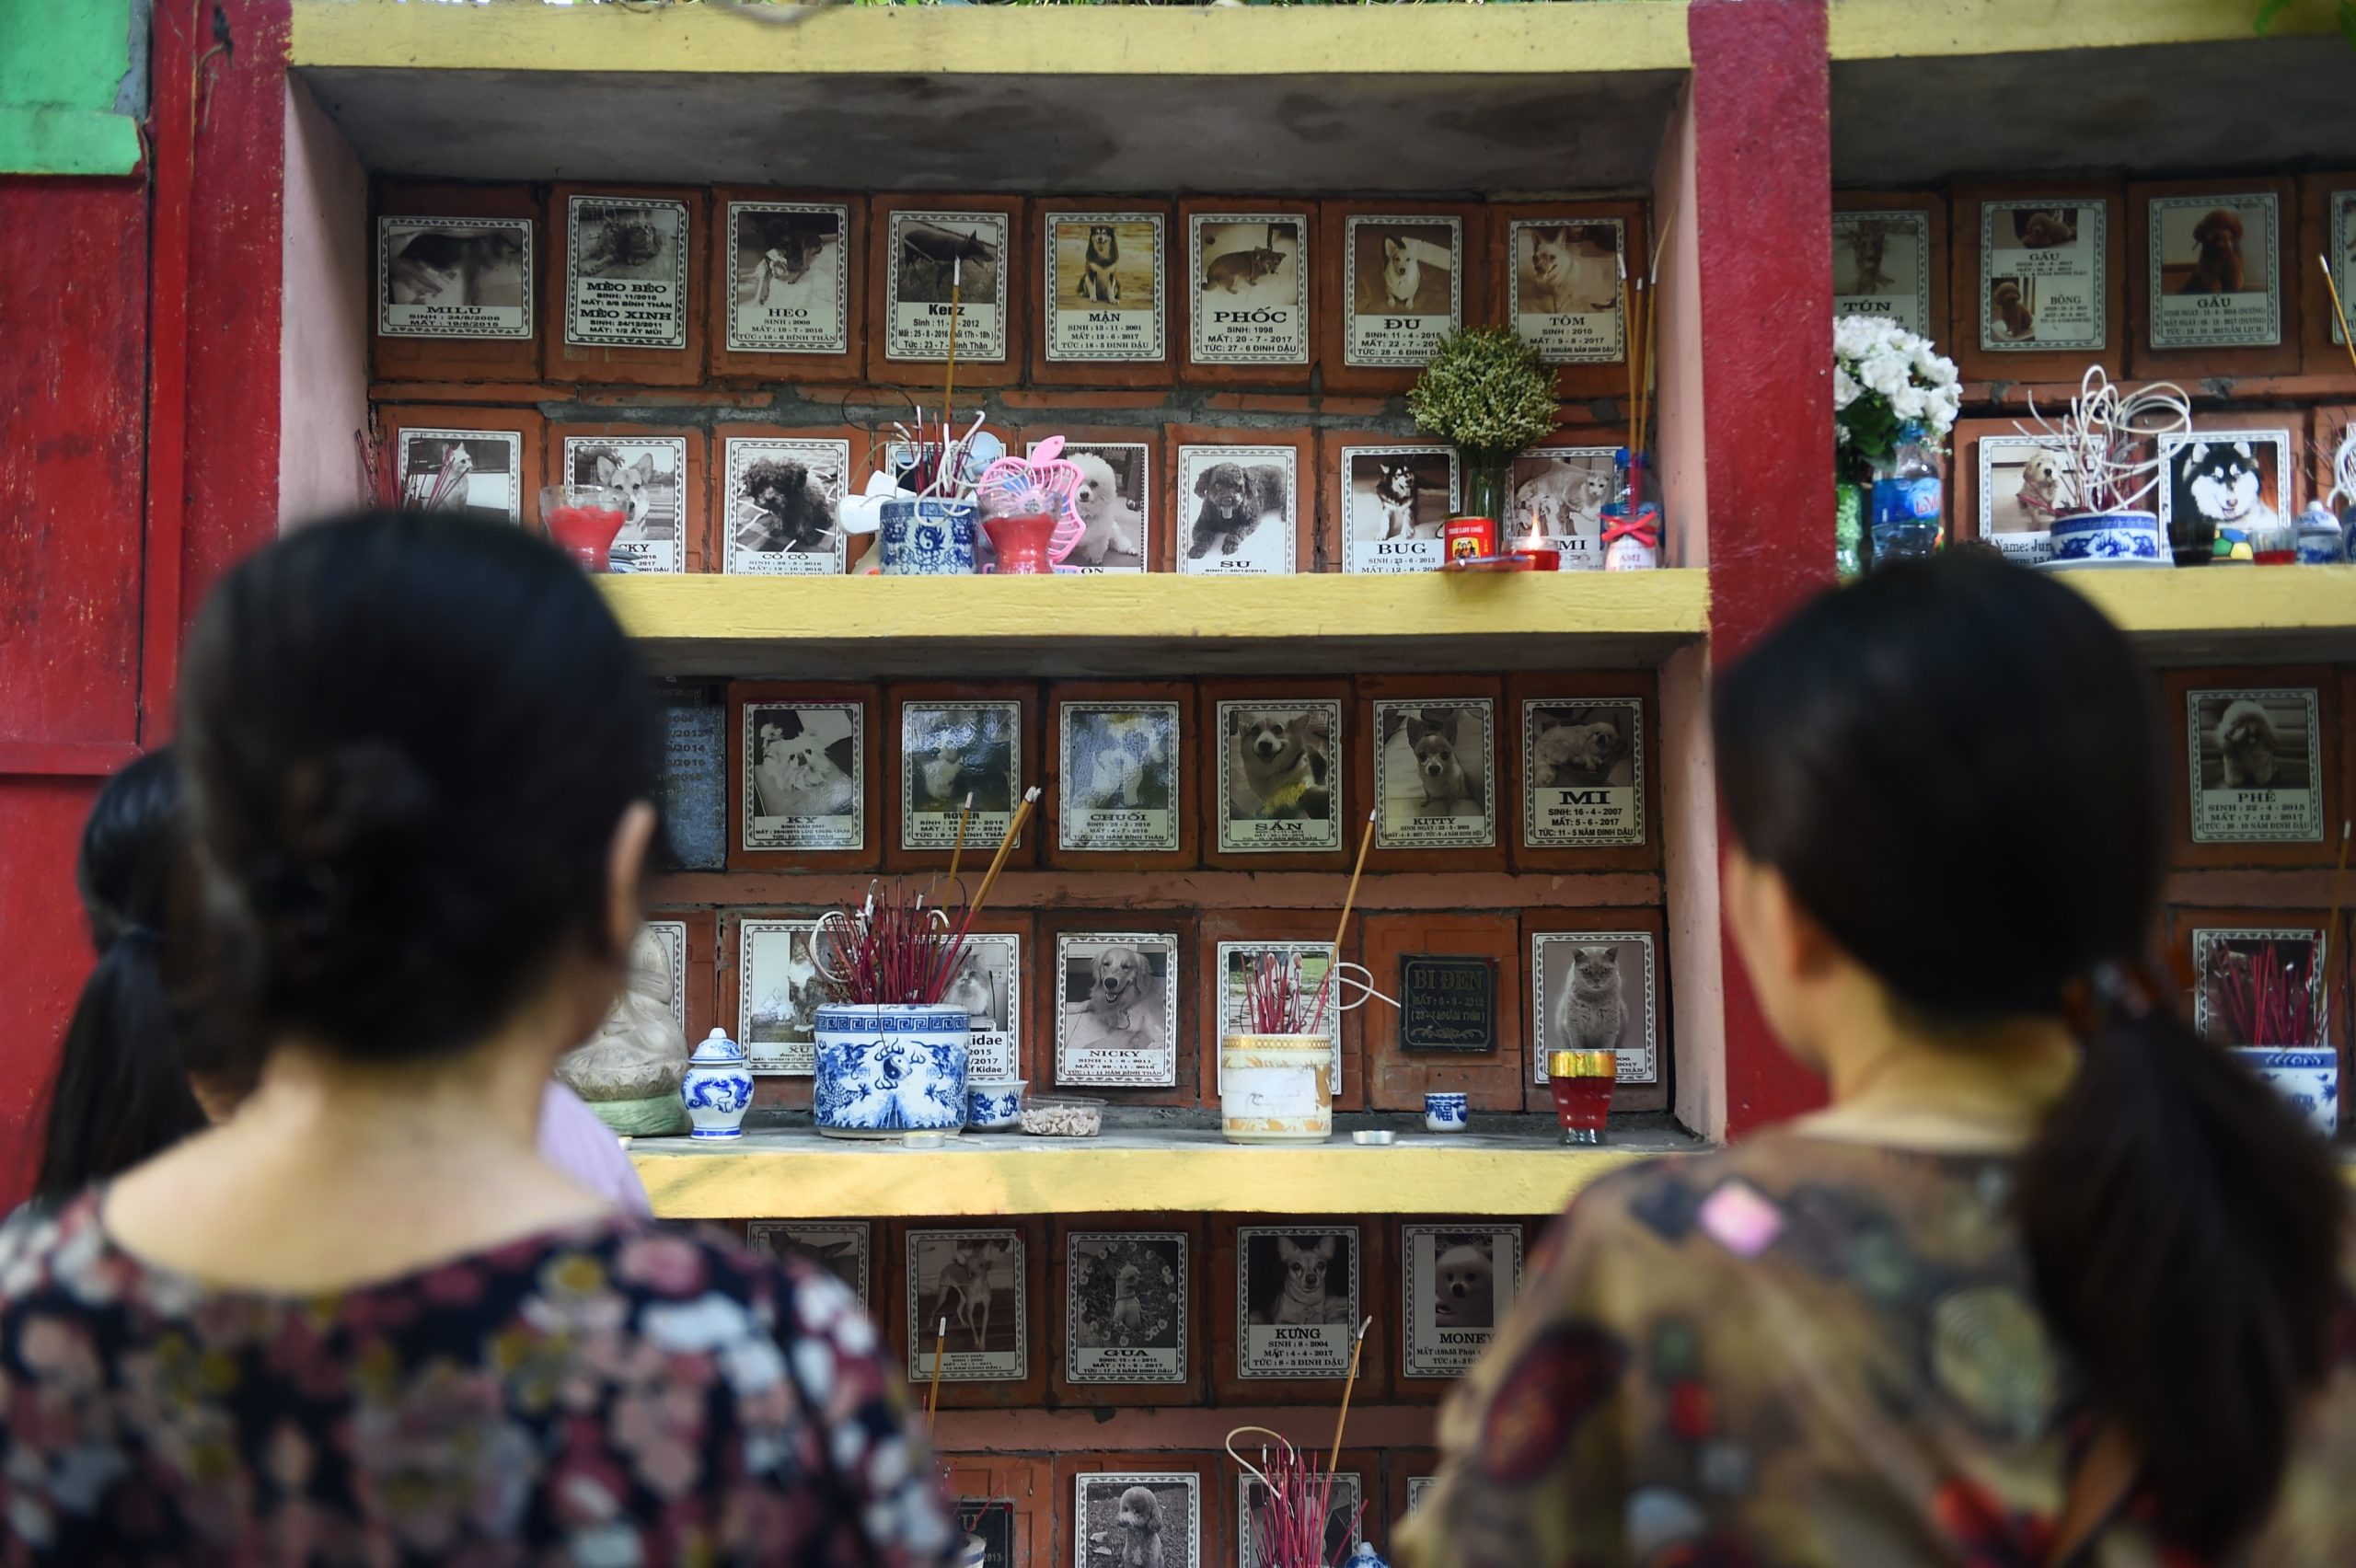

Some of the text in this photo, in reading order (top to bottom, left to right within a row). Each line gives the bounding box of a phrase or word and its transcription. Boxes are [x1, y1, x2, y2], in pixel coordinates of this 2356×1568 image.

[586, 281, 666, 293] MÈO BÉO
[427, 306, 482, 315] MILU
[1842, 298, 1892, 312] TÚN
[580, 307, 672, 320] MÈO XINH
[768, 308, 808, 317] HEO
[1089, 311, 1121, 325] MẬN
[1214, 306, 1287, 323] PHỐC
[913, 318, 930, 327] Sinh
[962, 319, 979, 328] 2012
[1384, 318, 1421, 329] ĐU
[1549, 315, 1585, 326] TÔM
[1207, 334, 1232, 342] MẤT:
[1361, 339, 1385, 347] MẤT:
[1530, 336, 1549, 344] MẤT
[904, 340, 918, 349] Tức
[970, 341, 987, 350] Thân
[1377, 542, 1427, 555] BUG
[1362, 565, 1383, 573] MẤT
[1558, 790, 1611, 804] MI
[1552, 816, 1573, 825] MẤT:
[1538, 827, 1556, 836] TỨC:
[1578, 827, 1596, 836] NĂM
[1617, 827, 1634, 837] DẬU
[1414, 970, 1483, 989] BI ĐEN
[969, 1034, 1003, 1045] idae
[1439, 1332, 1495, 1344] MONEY
[1416, 1347, 1433, 1355] MẤT
